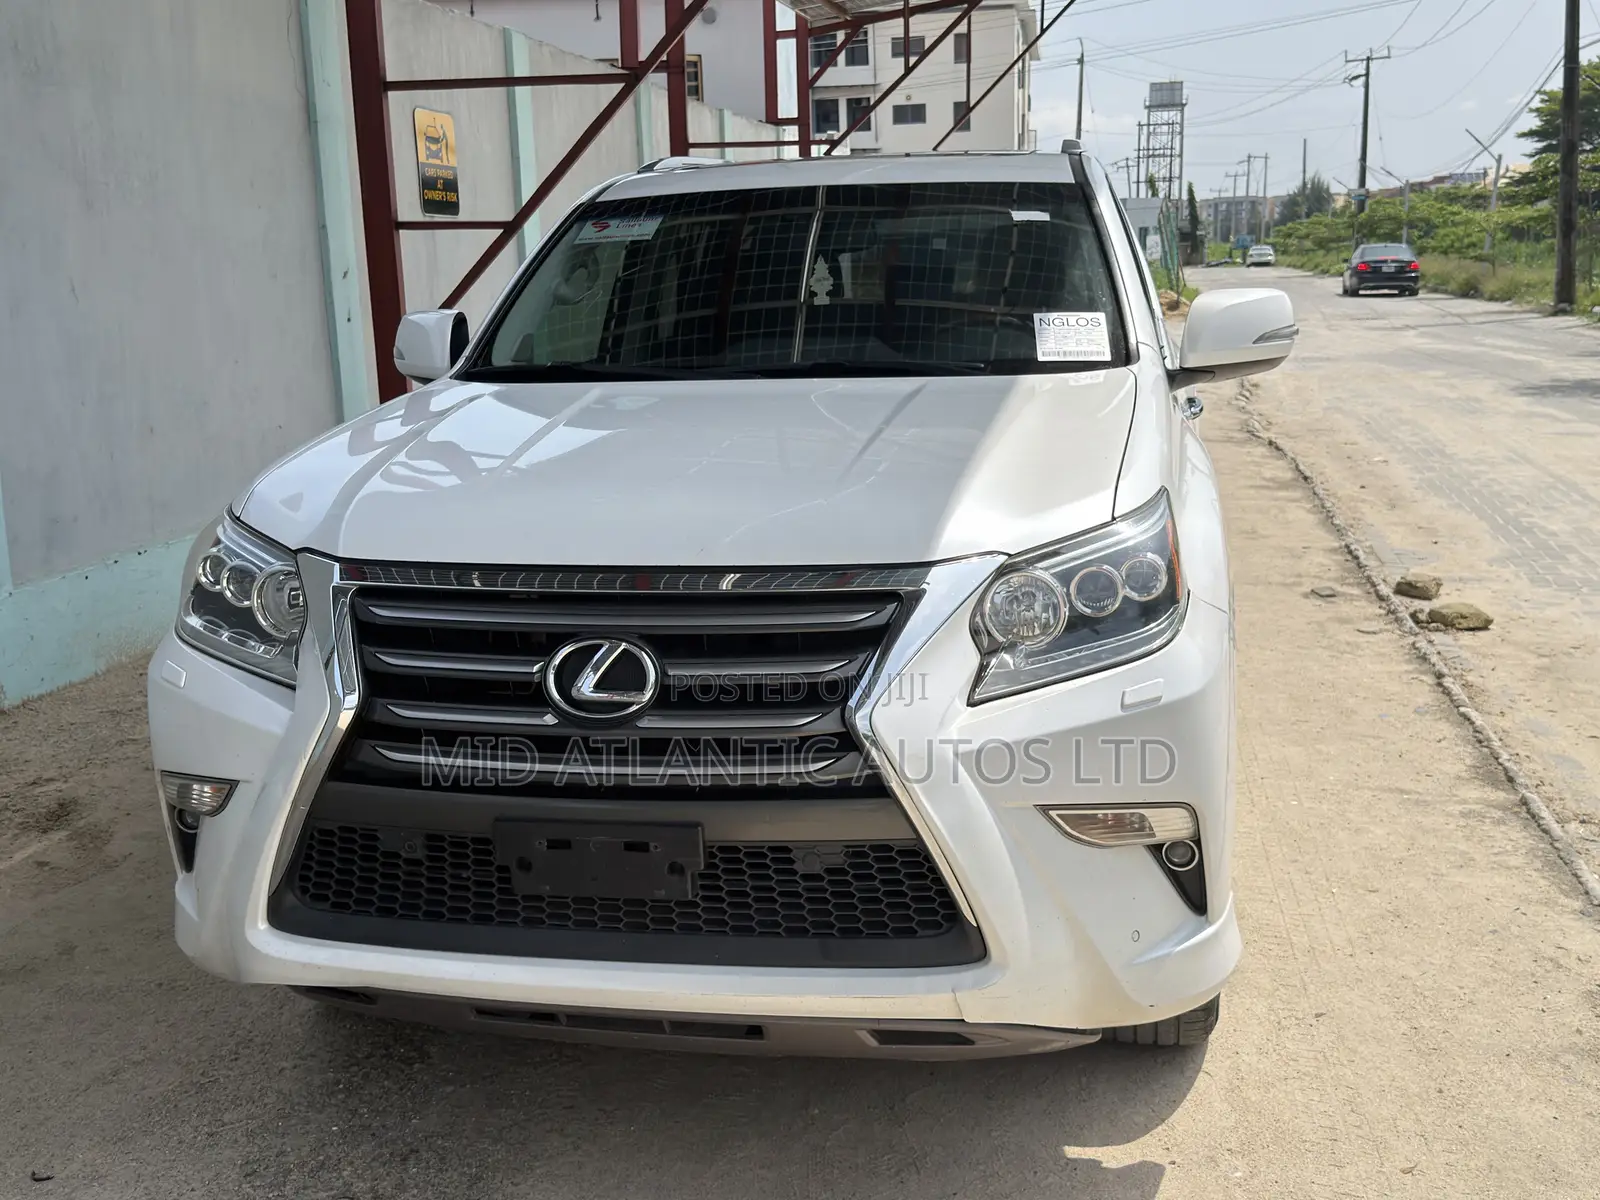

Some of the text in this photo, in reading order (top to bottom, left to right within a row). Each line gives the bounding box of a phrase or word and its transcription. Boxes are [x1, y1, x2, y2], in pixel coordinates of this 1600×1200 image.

[425, 167, 453, 179] CARS PARKED
[437, 179, 443, 189] AT
[424, 189, 457, 202] OWNER'S RISK
[1039, 317, 1101, 327] NGLOS
